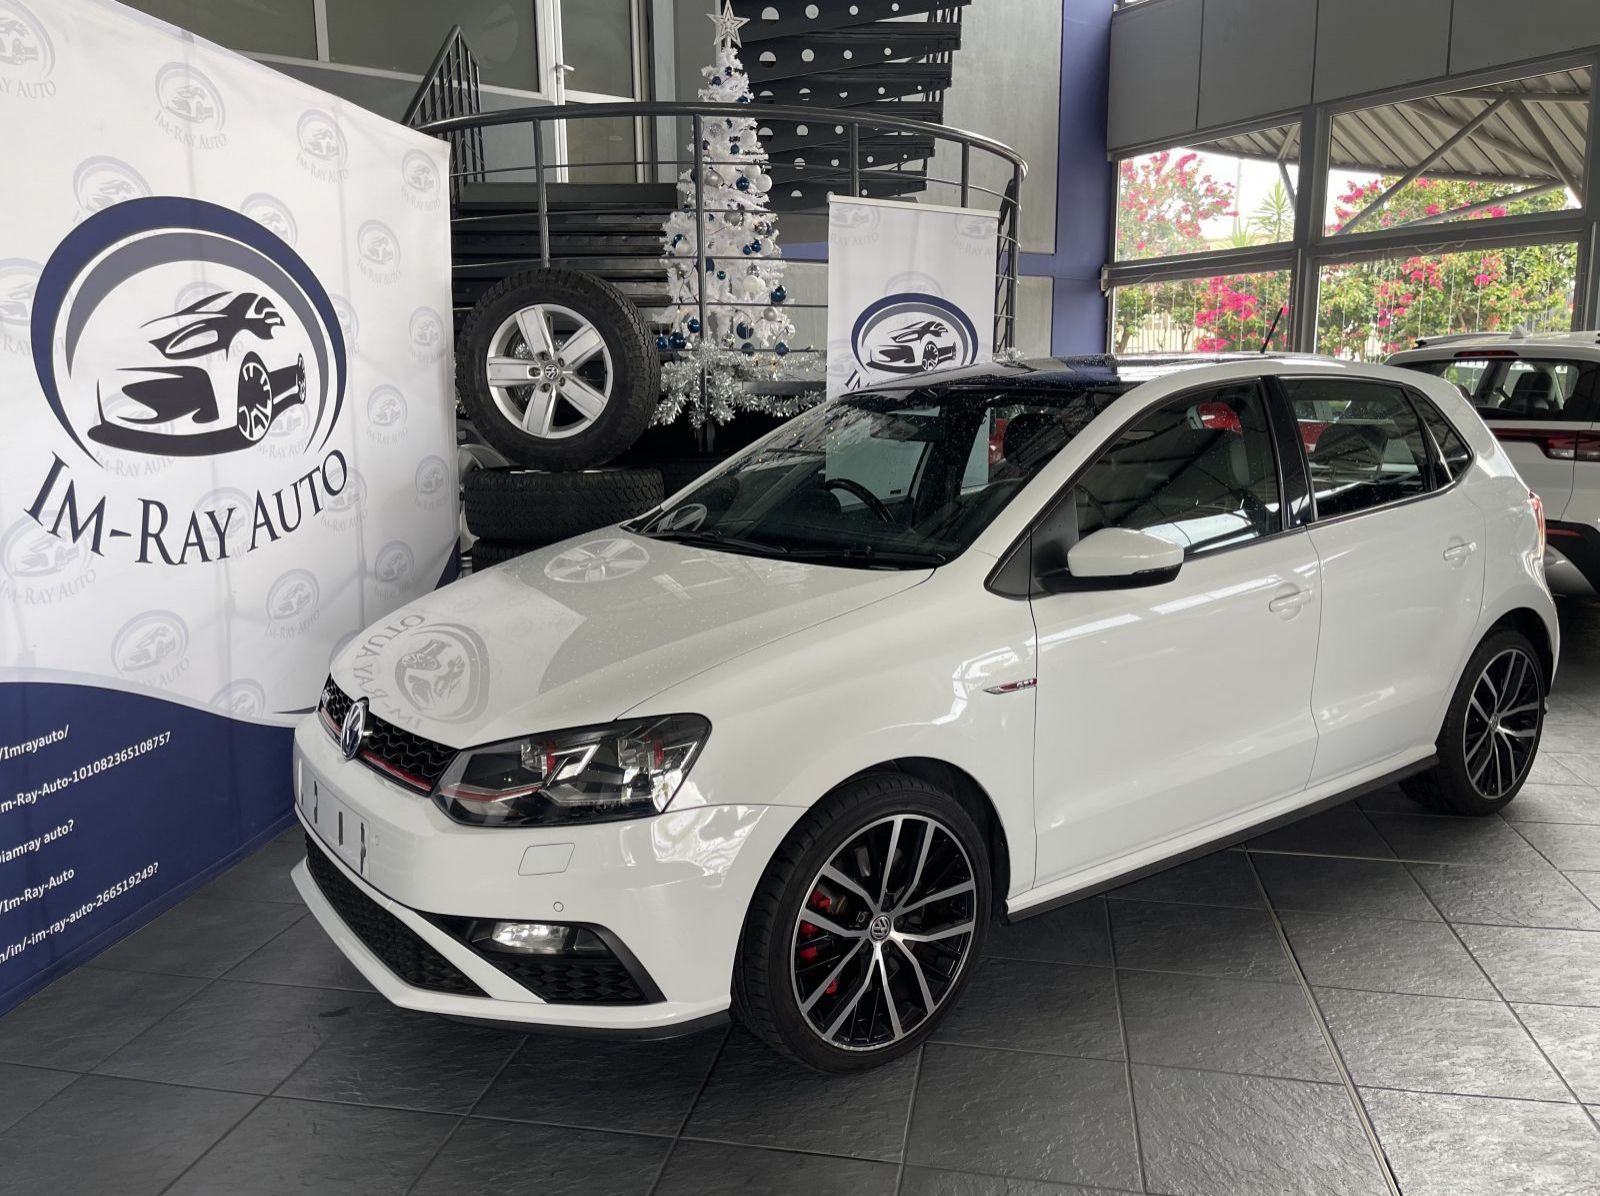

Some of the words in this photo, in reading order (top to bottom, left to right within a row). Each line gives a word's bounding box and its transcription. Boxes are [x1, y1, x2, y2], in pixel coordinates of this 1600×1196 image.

[16, 79, 57, 99] AUTO
[199, 132, 228, 152] AUTO
[24, 450, 237, 566] IM-RAY
[247, 449, 348, 553] AUTO
[59, 568, 97, 600] AUTO
[0, 731, 171, 814] m-Ray-Auto-101082365108757
[44, 819, 74, 844] auto?
